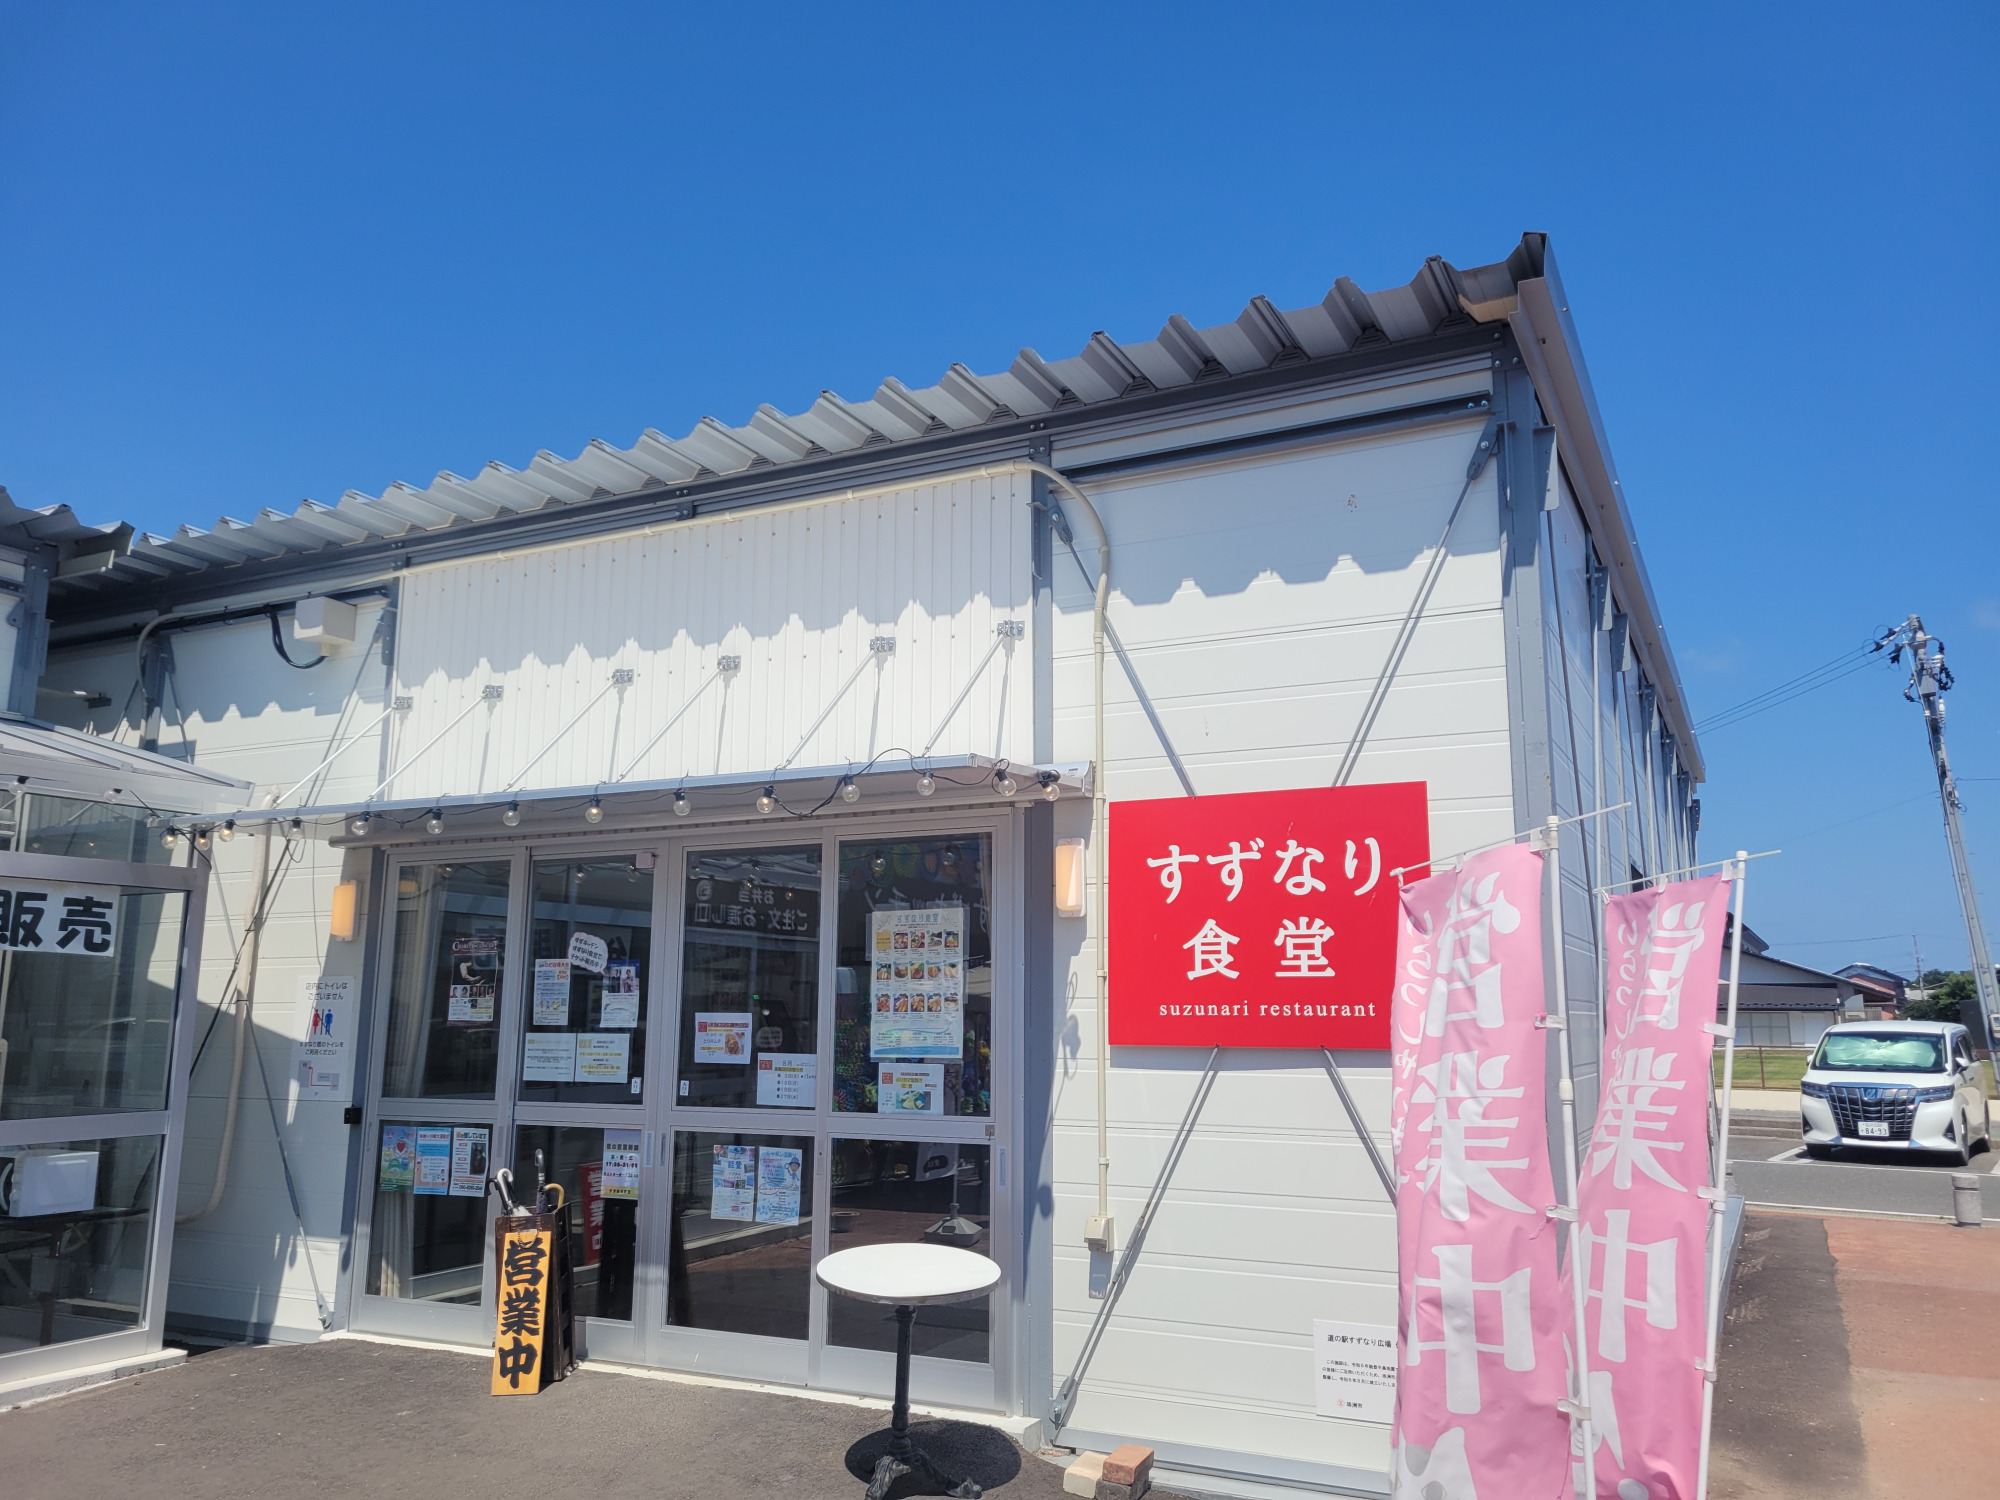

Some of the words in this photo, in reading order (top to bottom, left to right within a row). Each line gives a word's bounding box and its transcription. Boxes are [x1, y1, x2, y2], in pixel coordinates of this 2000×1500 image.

[1146, 837, 1382, 904] すずなり
[0, 888, 114, 954] 販売
[1182, 916, 1336, 981] 食堂
[305, 982, 348, 991] 店内にトイレは
[308, 992, 345, 1001] ございません
[1159, 999, 1250, 1017] suzunari
[1258, 1000, 1377, 1018] restaurant
[1406, 871, 1537, 1415] 営業中
[1578, 900, 1705, 1363] 営業中
[498, 1237, 548, 1390] 営業中
